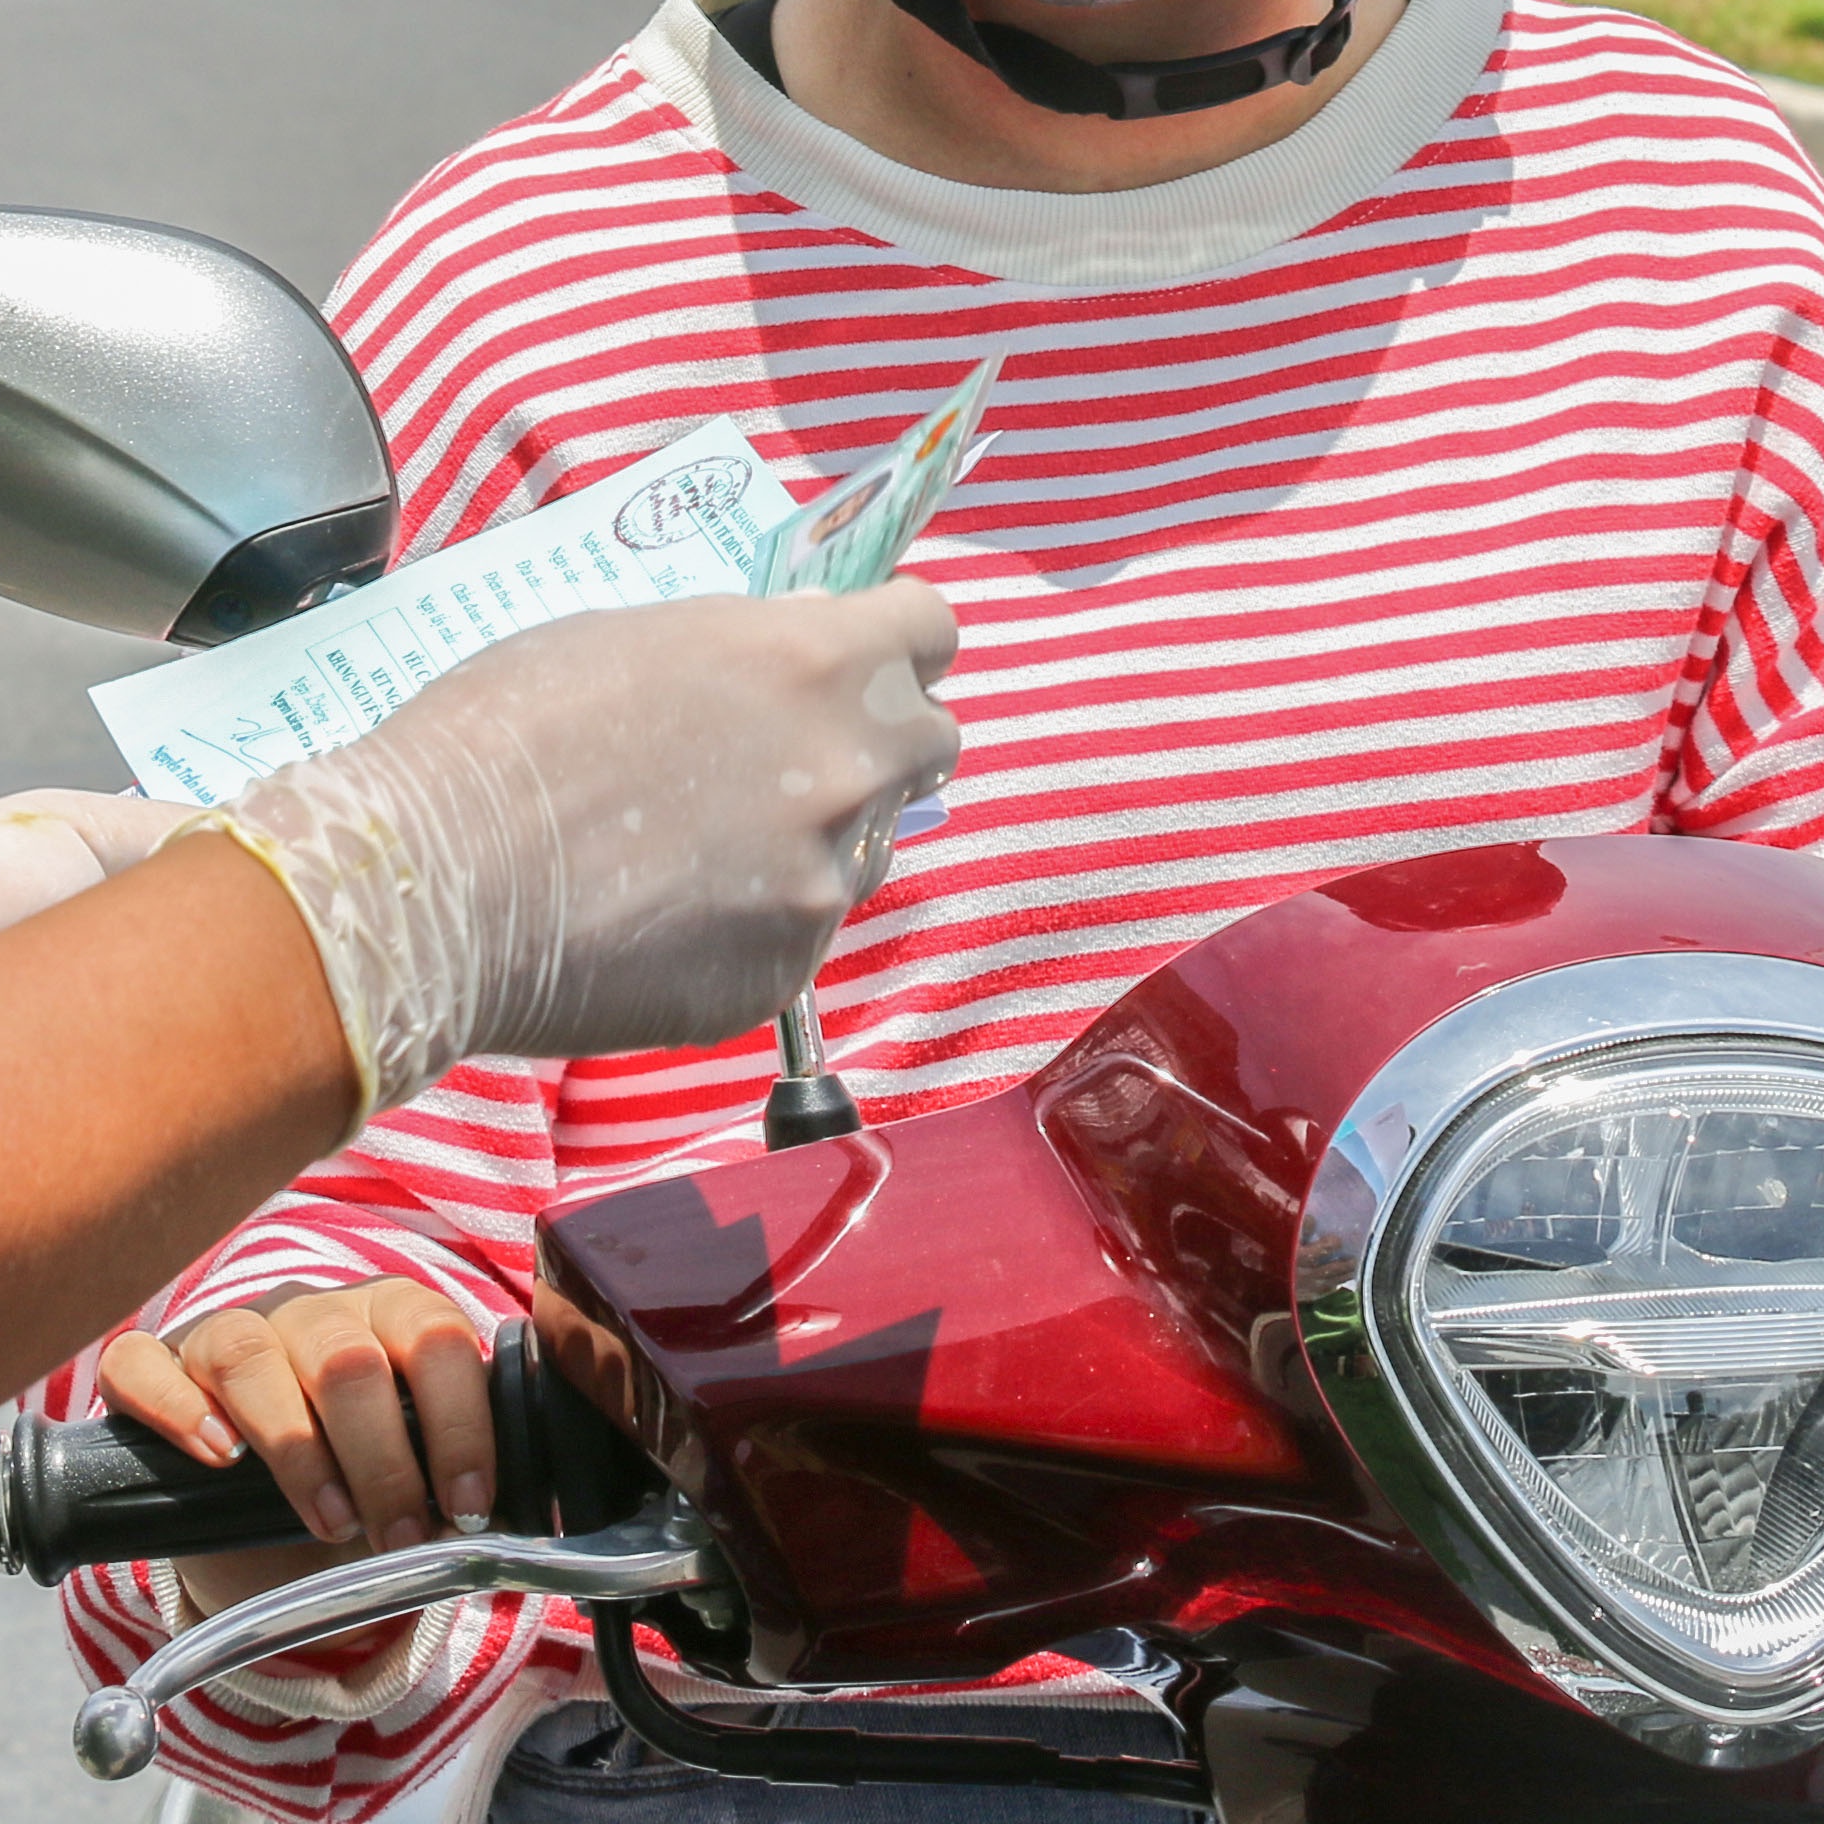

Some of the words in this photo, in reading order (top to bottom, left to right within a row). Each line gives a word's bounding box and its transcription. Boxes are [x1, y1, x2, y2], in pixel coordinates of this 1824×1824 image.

[714, 525, 733, 540] TẾ
[730, 506, 761, 540] KHÁNH
[721, 536, 744, 557] DIÊN
[402, 650, 424, 670] YÊU
[369, 667, 392, 687] XÉT
[326, 649, 357, 681] KHÁNG
[347, 679, 385, 727] NGUYÊN
[298, 731, 313, 748] tra
[193, 786, 216, 805] Anh
